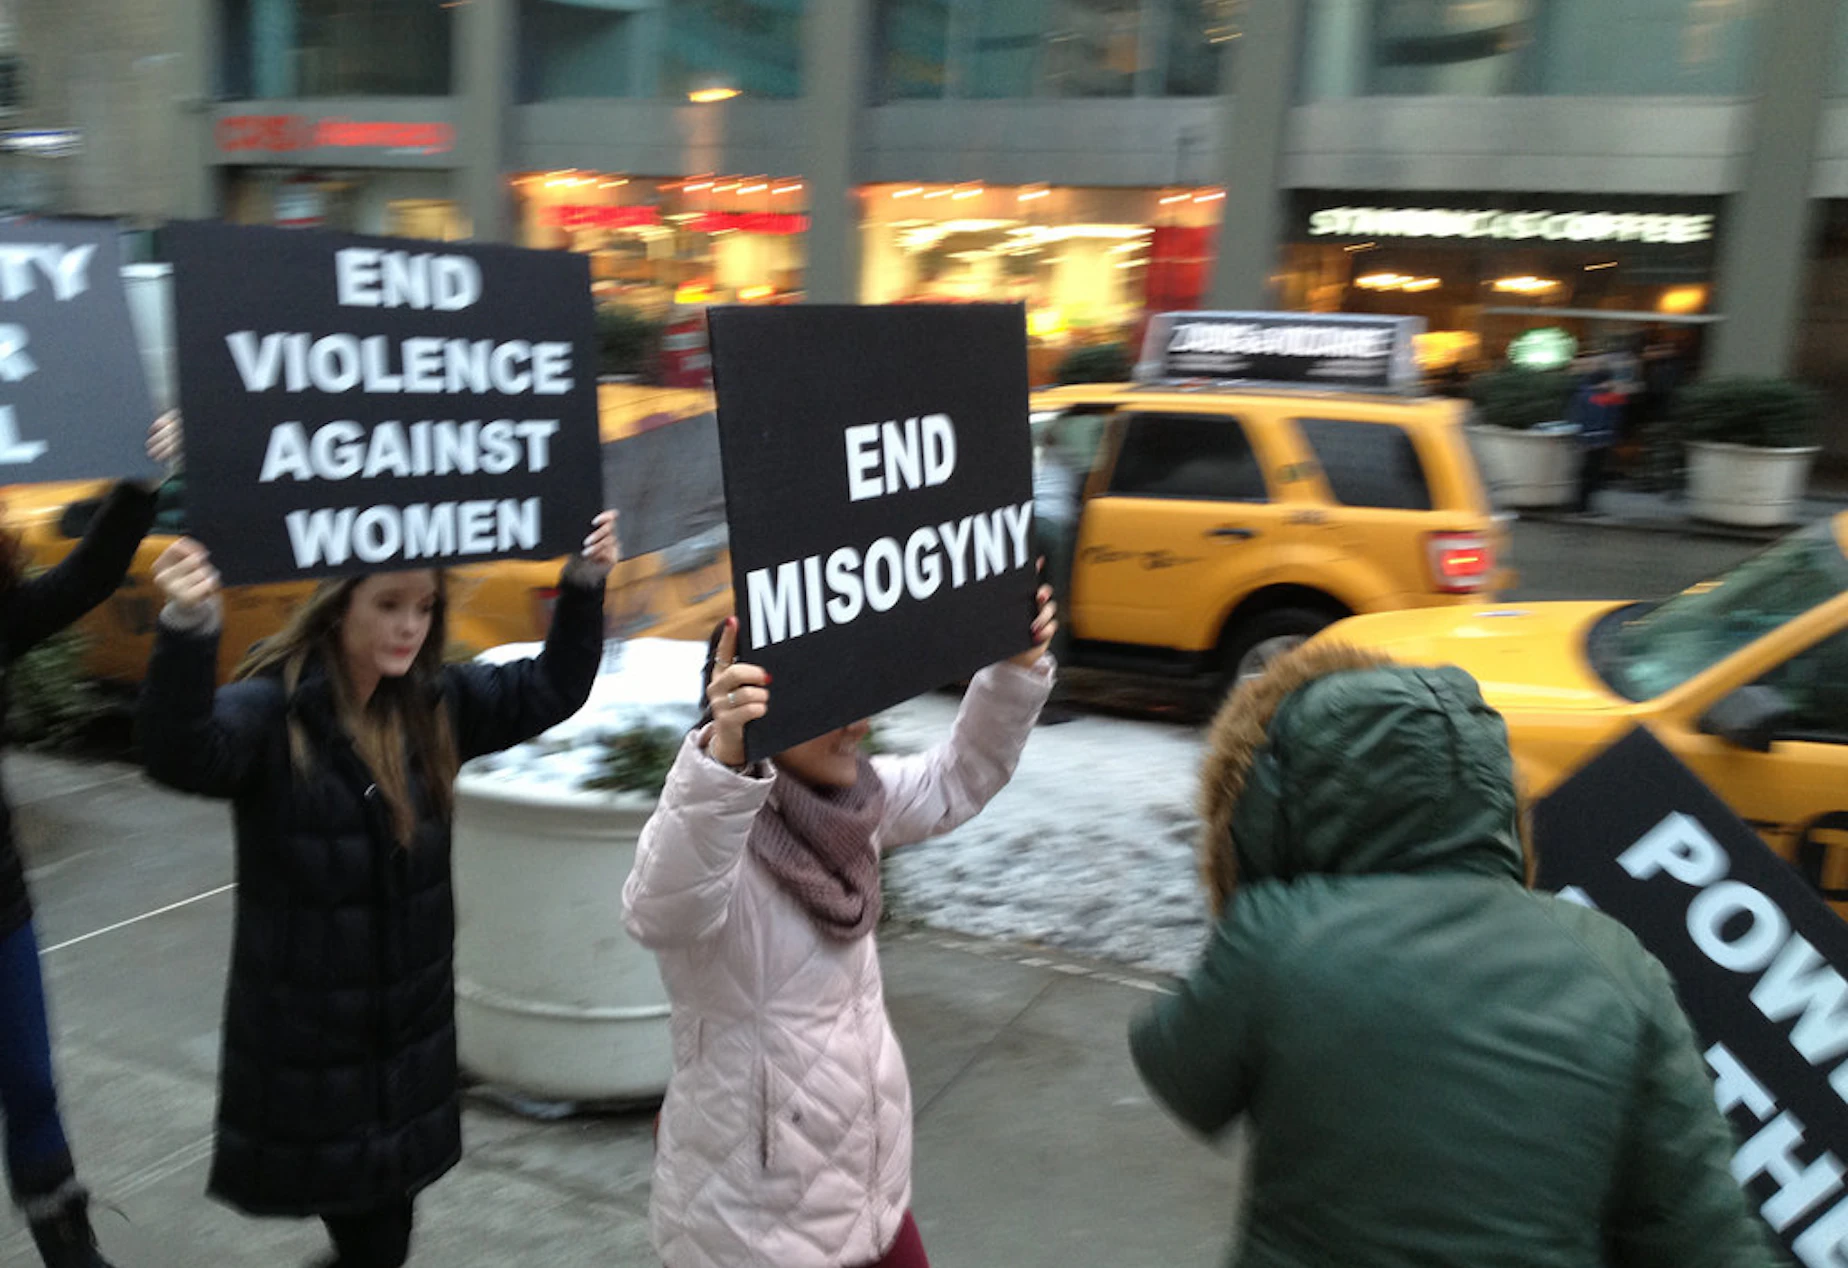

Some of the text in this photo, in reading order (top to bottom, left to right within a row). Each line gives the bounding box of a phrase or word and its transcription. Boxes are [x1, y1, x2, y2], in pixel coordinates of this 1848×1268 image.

[335, 247, 483, 311] END
[224, 330, 575, 395] VIOLENCE
[258, 418, 561, 483] AGAINST
[845, 413, 957, 502] END
[285, 496, 543, 569] WOMEN
[746, 500, 1034, 650] MISOGYNY
[1615, 810, 1848, 1104] POW
